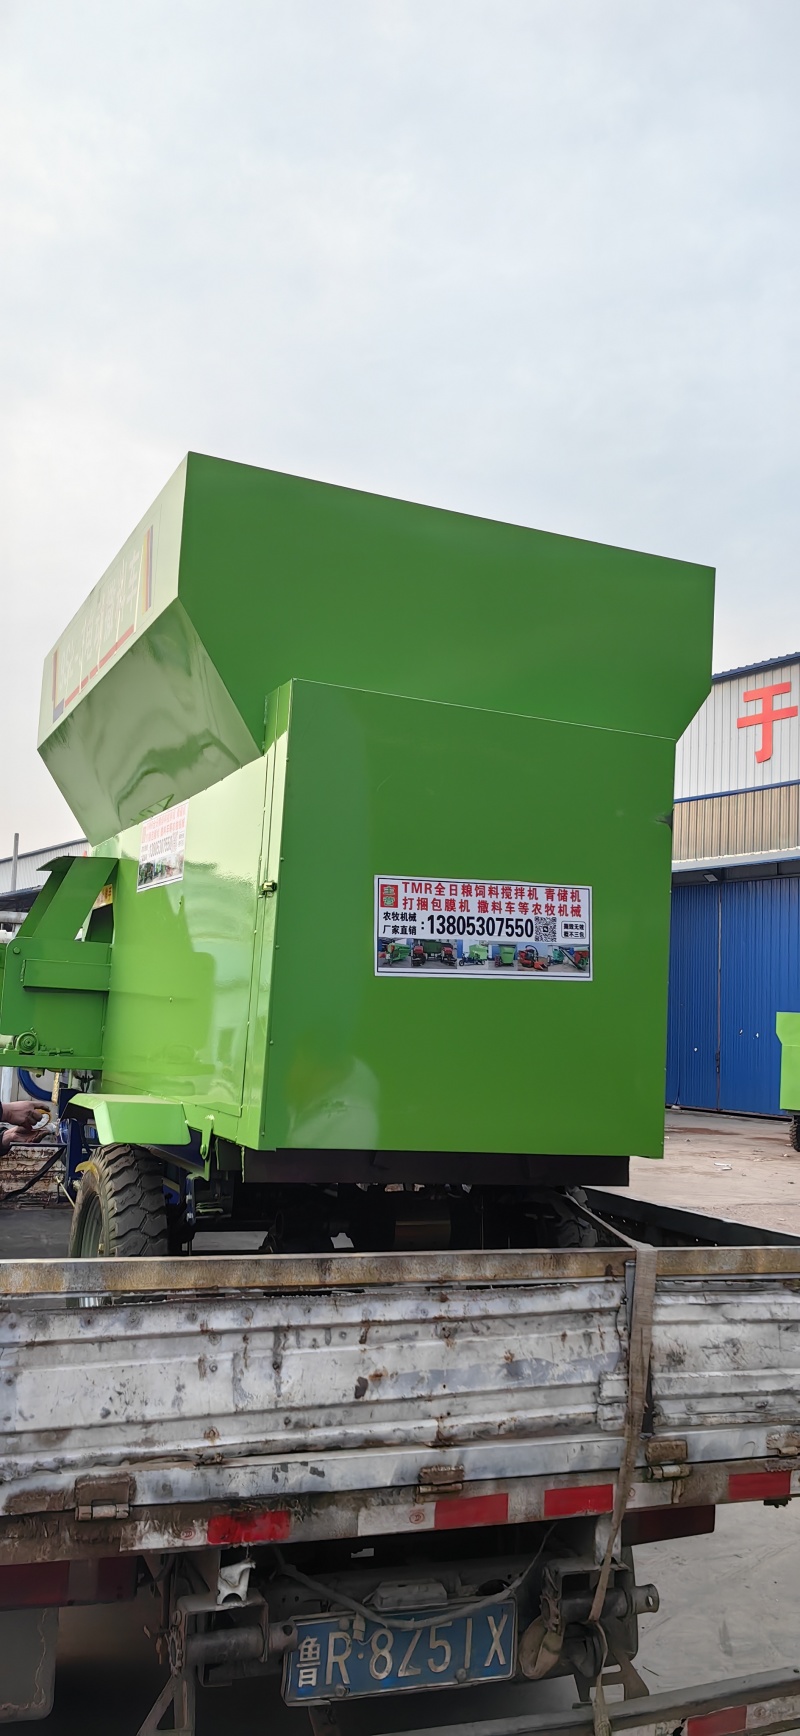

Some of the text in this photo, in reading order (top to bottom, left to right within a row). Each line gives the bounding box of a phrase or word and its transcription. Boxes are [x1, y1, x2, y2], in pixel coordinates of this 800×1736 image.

[402, 881, 581, 903] TMR全日粮饲料搅拌机 青储机
[402, 896, 582, 918] 打捆包膜机 撒料车等农牧机械
[382, 911, 417, 922] 农牧机械
[382, 924, 417, 936] 厂家直销
